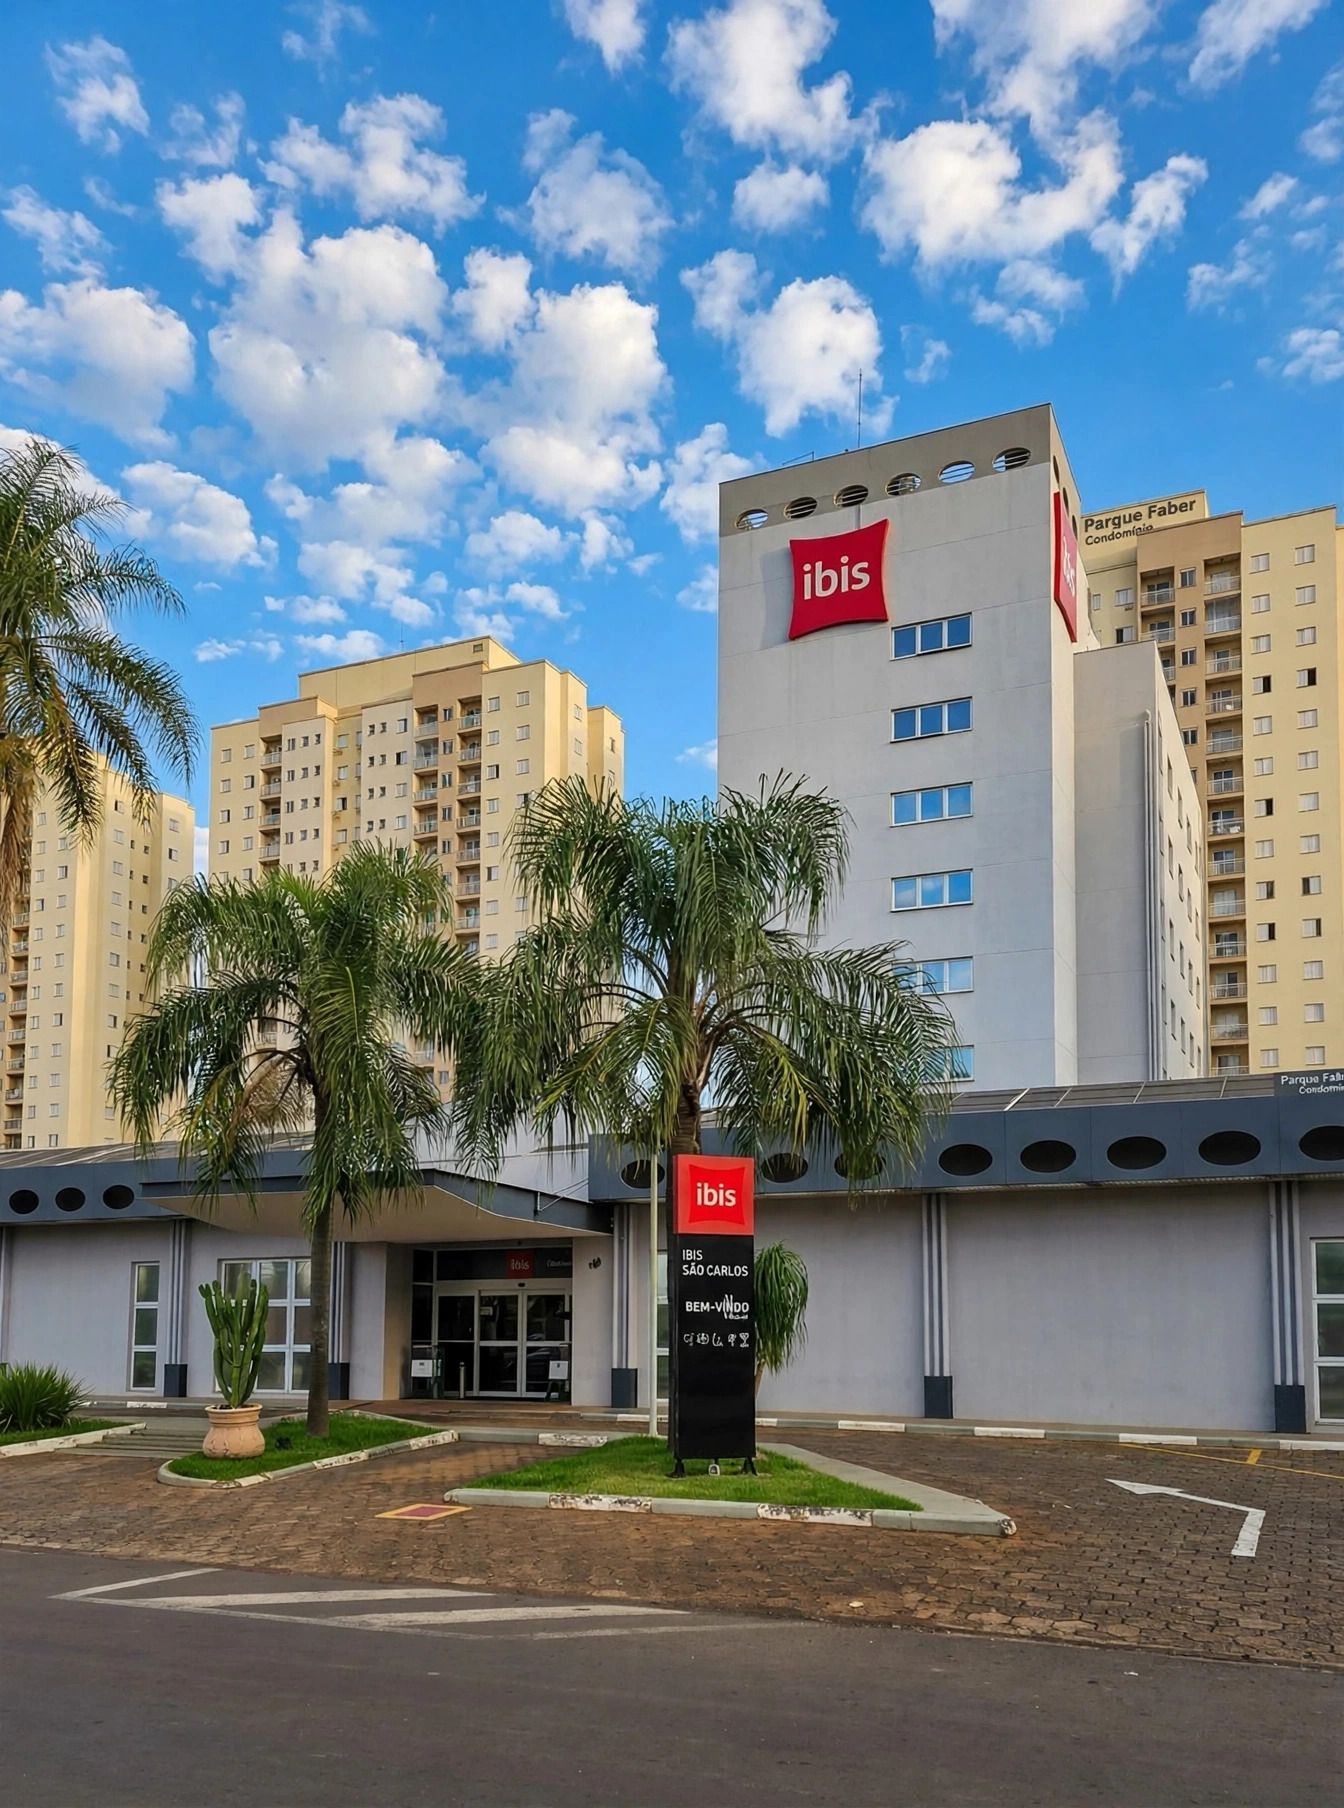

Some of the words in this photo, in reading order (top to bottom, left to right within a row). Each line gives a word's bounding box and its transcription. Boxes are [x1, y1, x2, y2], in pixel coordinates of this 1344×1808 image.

[1148, 499, 1196, 519] Faber
[802, 555, 870, 600] ibis
[696, 1182, 736, 1207] ibis
[682, 1249, 703, 1260] IBIS
[682, 1262, 704, 1276] SÃO
[706, 1265, 749, 1277] CARLOS
